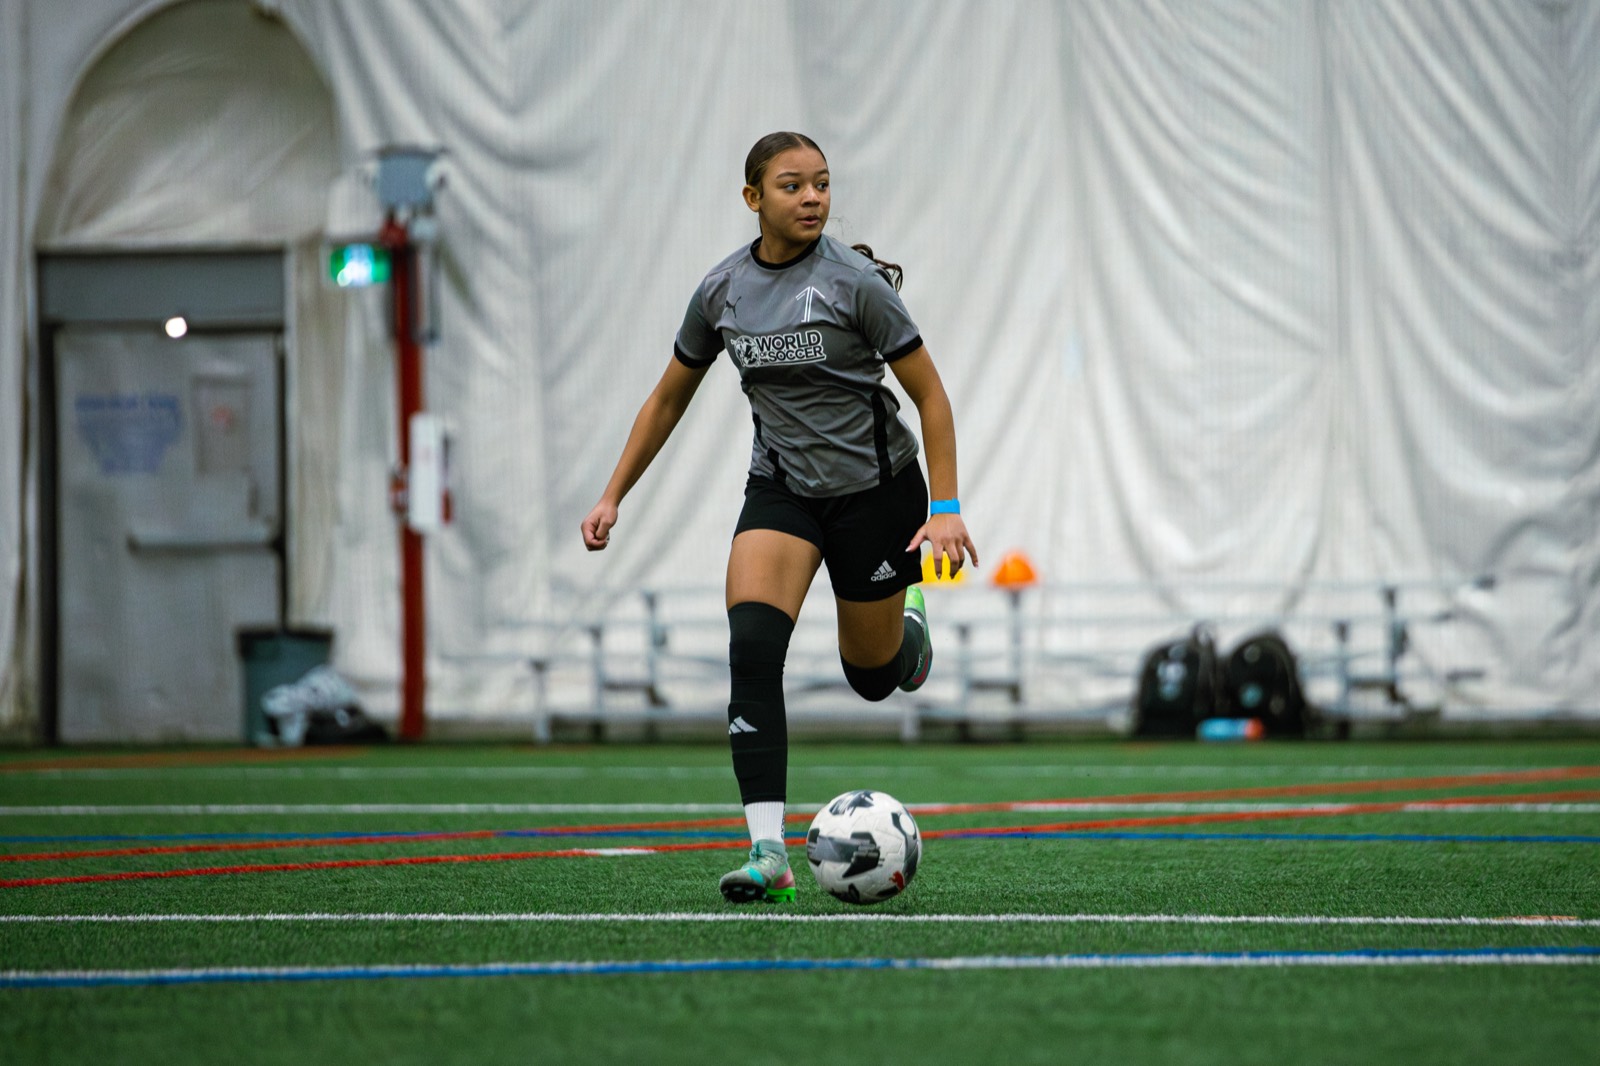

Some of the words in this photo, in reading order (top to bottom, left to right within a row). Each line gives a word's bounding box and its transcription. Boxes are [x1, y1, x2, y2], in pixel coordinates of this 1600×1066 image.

[755, 331, 821, 352] WORLD
[768, 346, 822, 362] SOCCER
[870, 570, 896, 581] adidas
